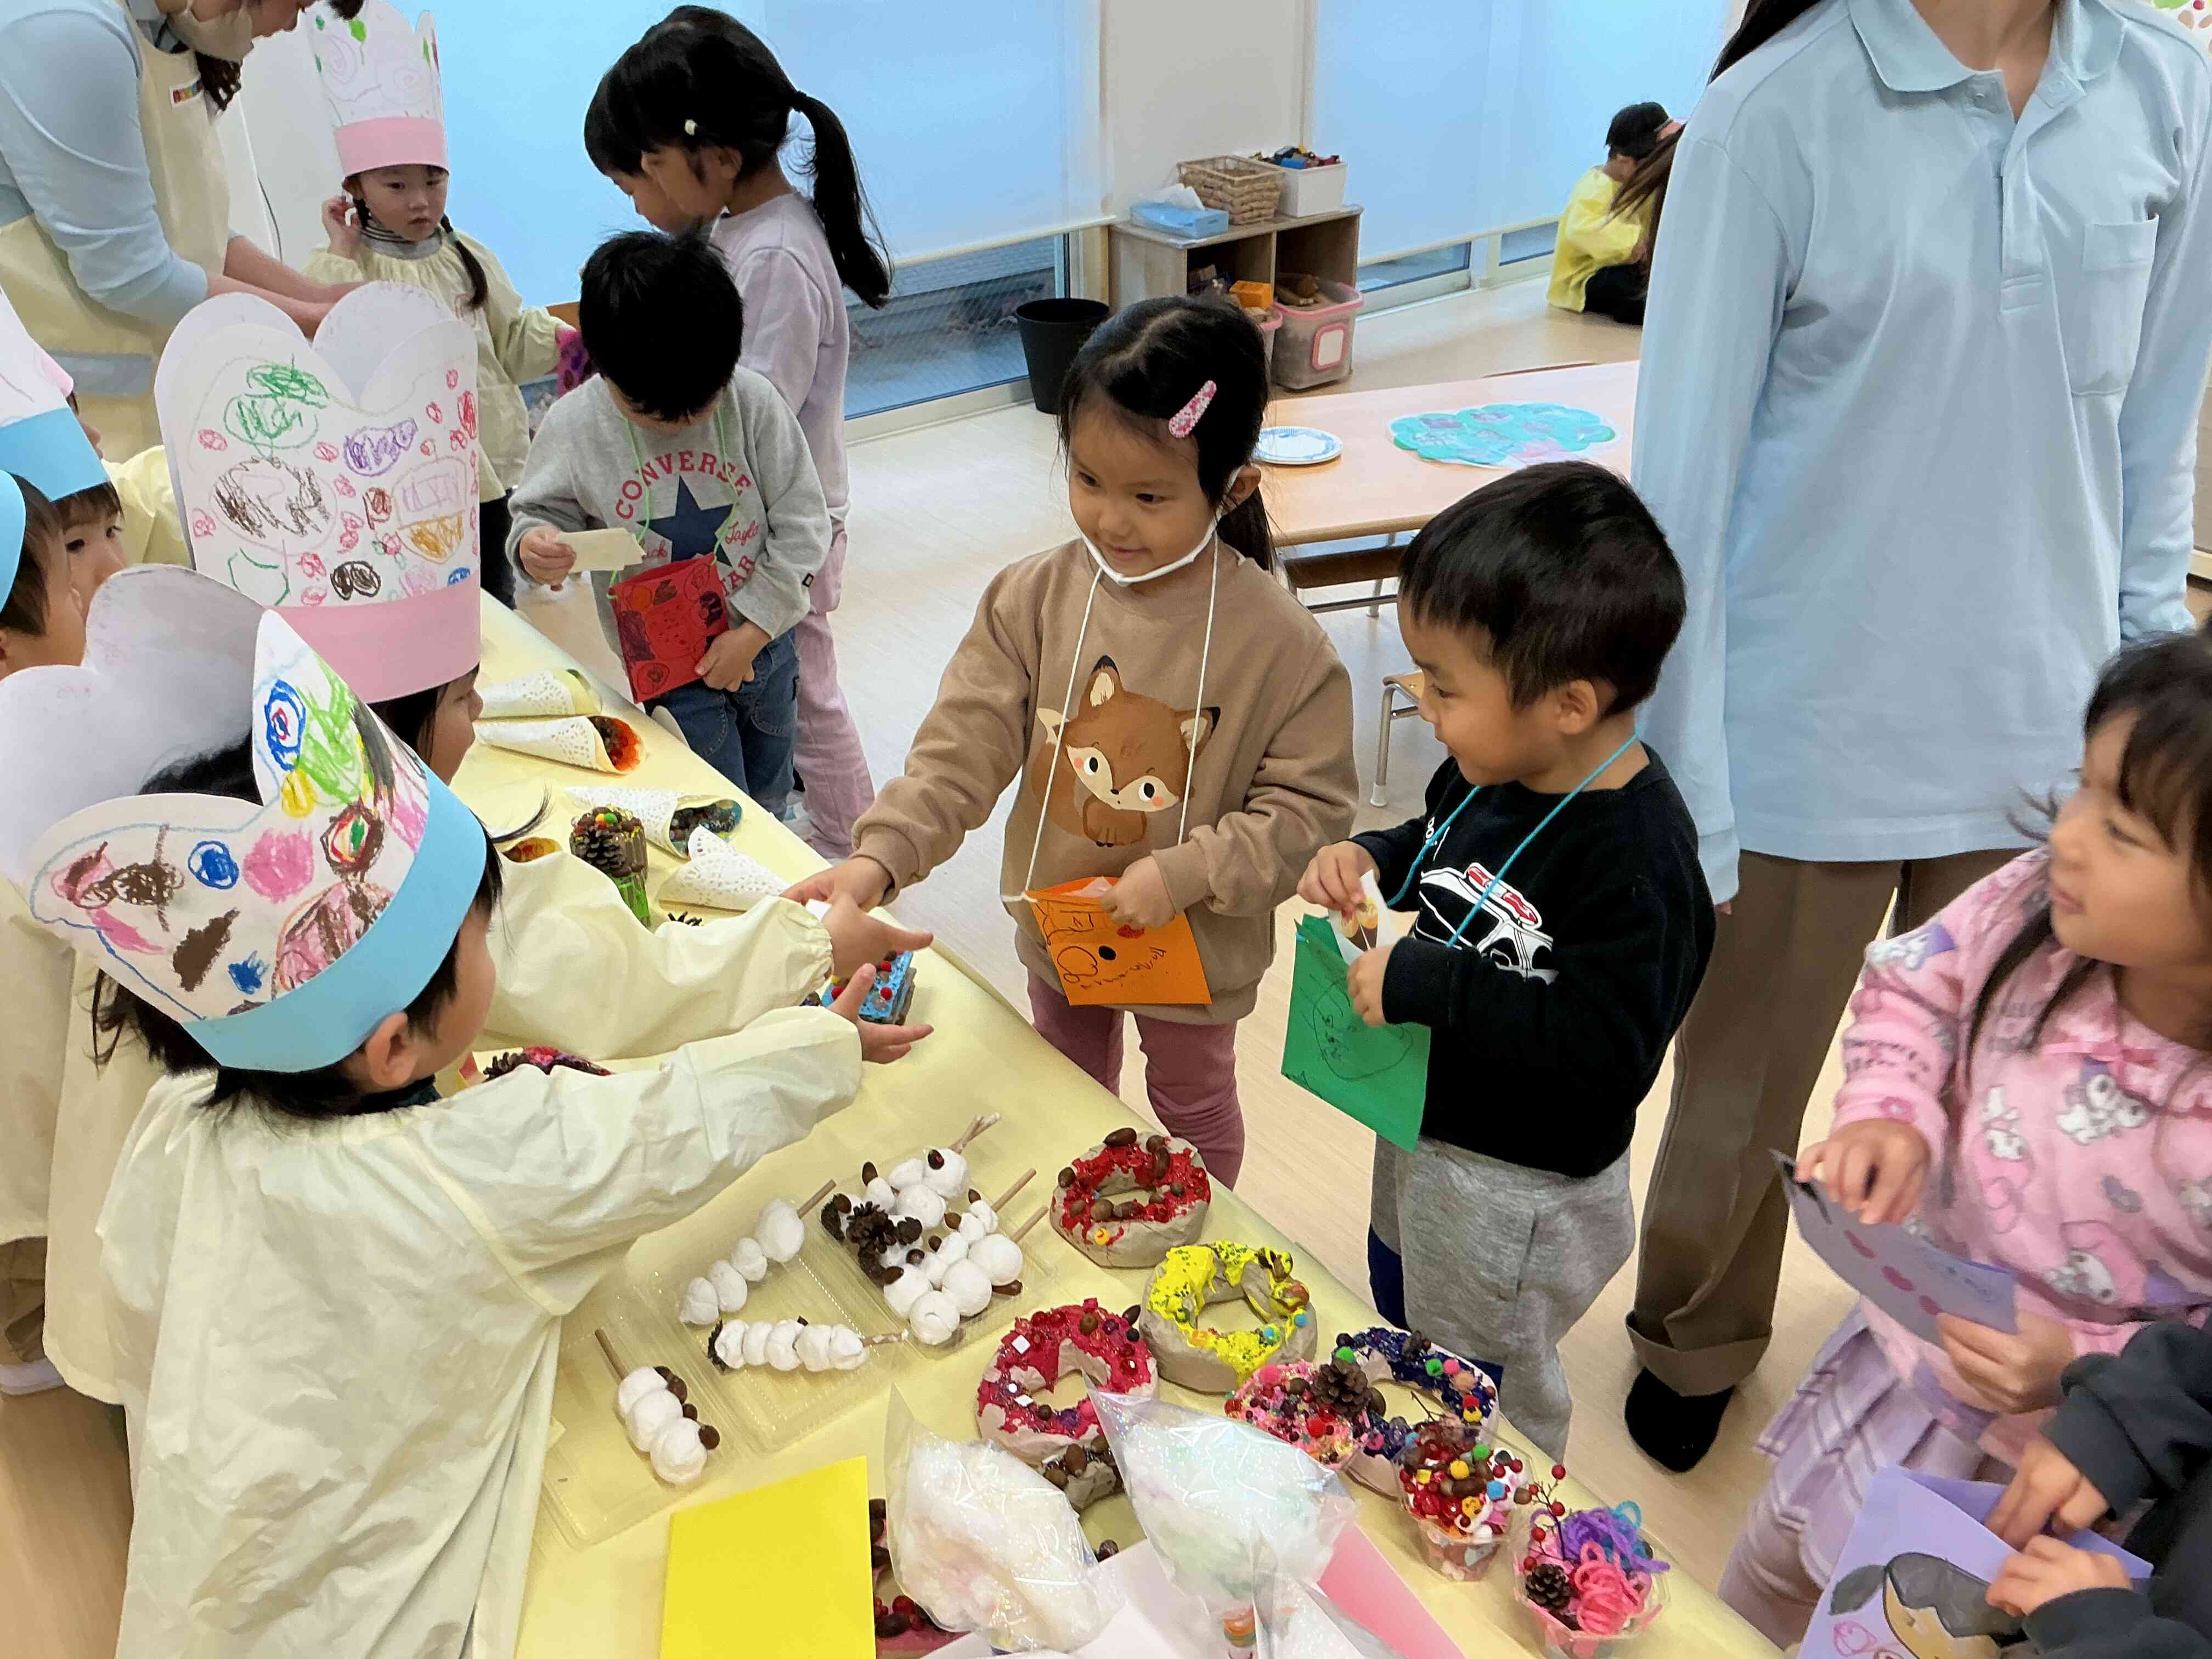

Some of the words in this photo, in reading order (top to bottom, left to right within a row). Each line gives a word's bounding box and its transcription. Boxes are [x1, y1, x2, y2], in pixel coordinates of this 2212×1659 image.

[616, 450, 752, 519] CONVERSE
[725, 520, 760, 546] Taylo
[720, 555, 755, 597] TAR
